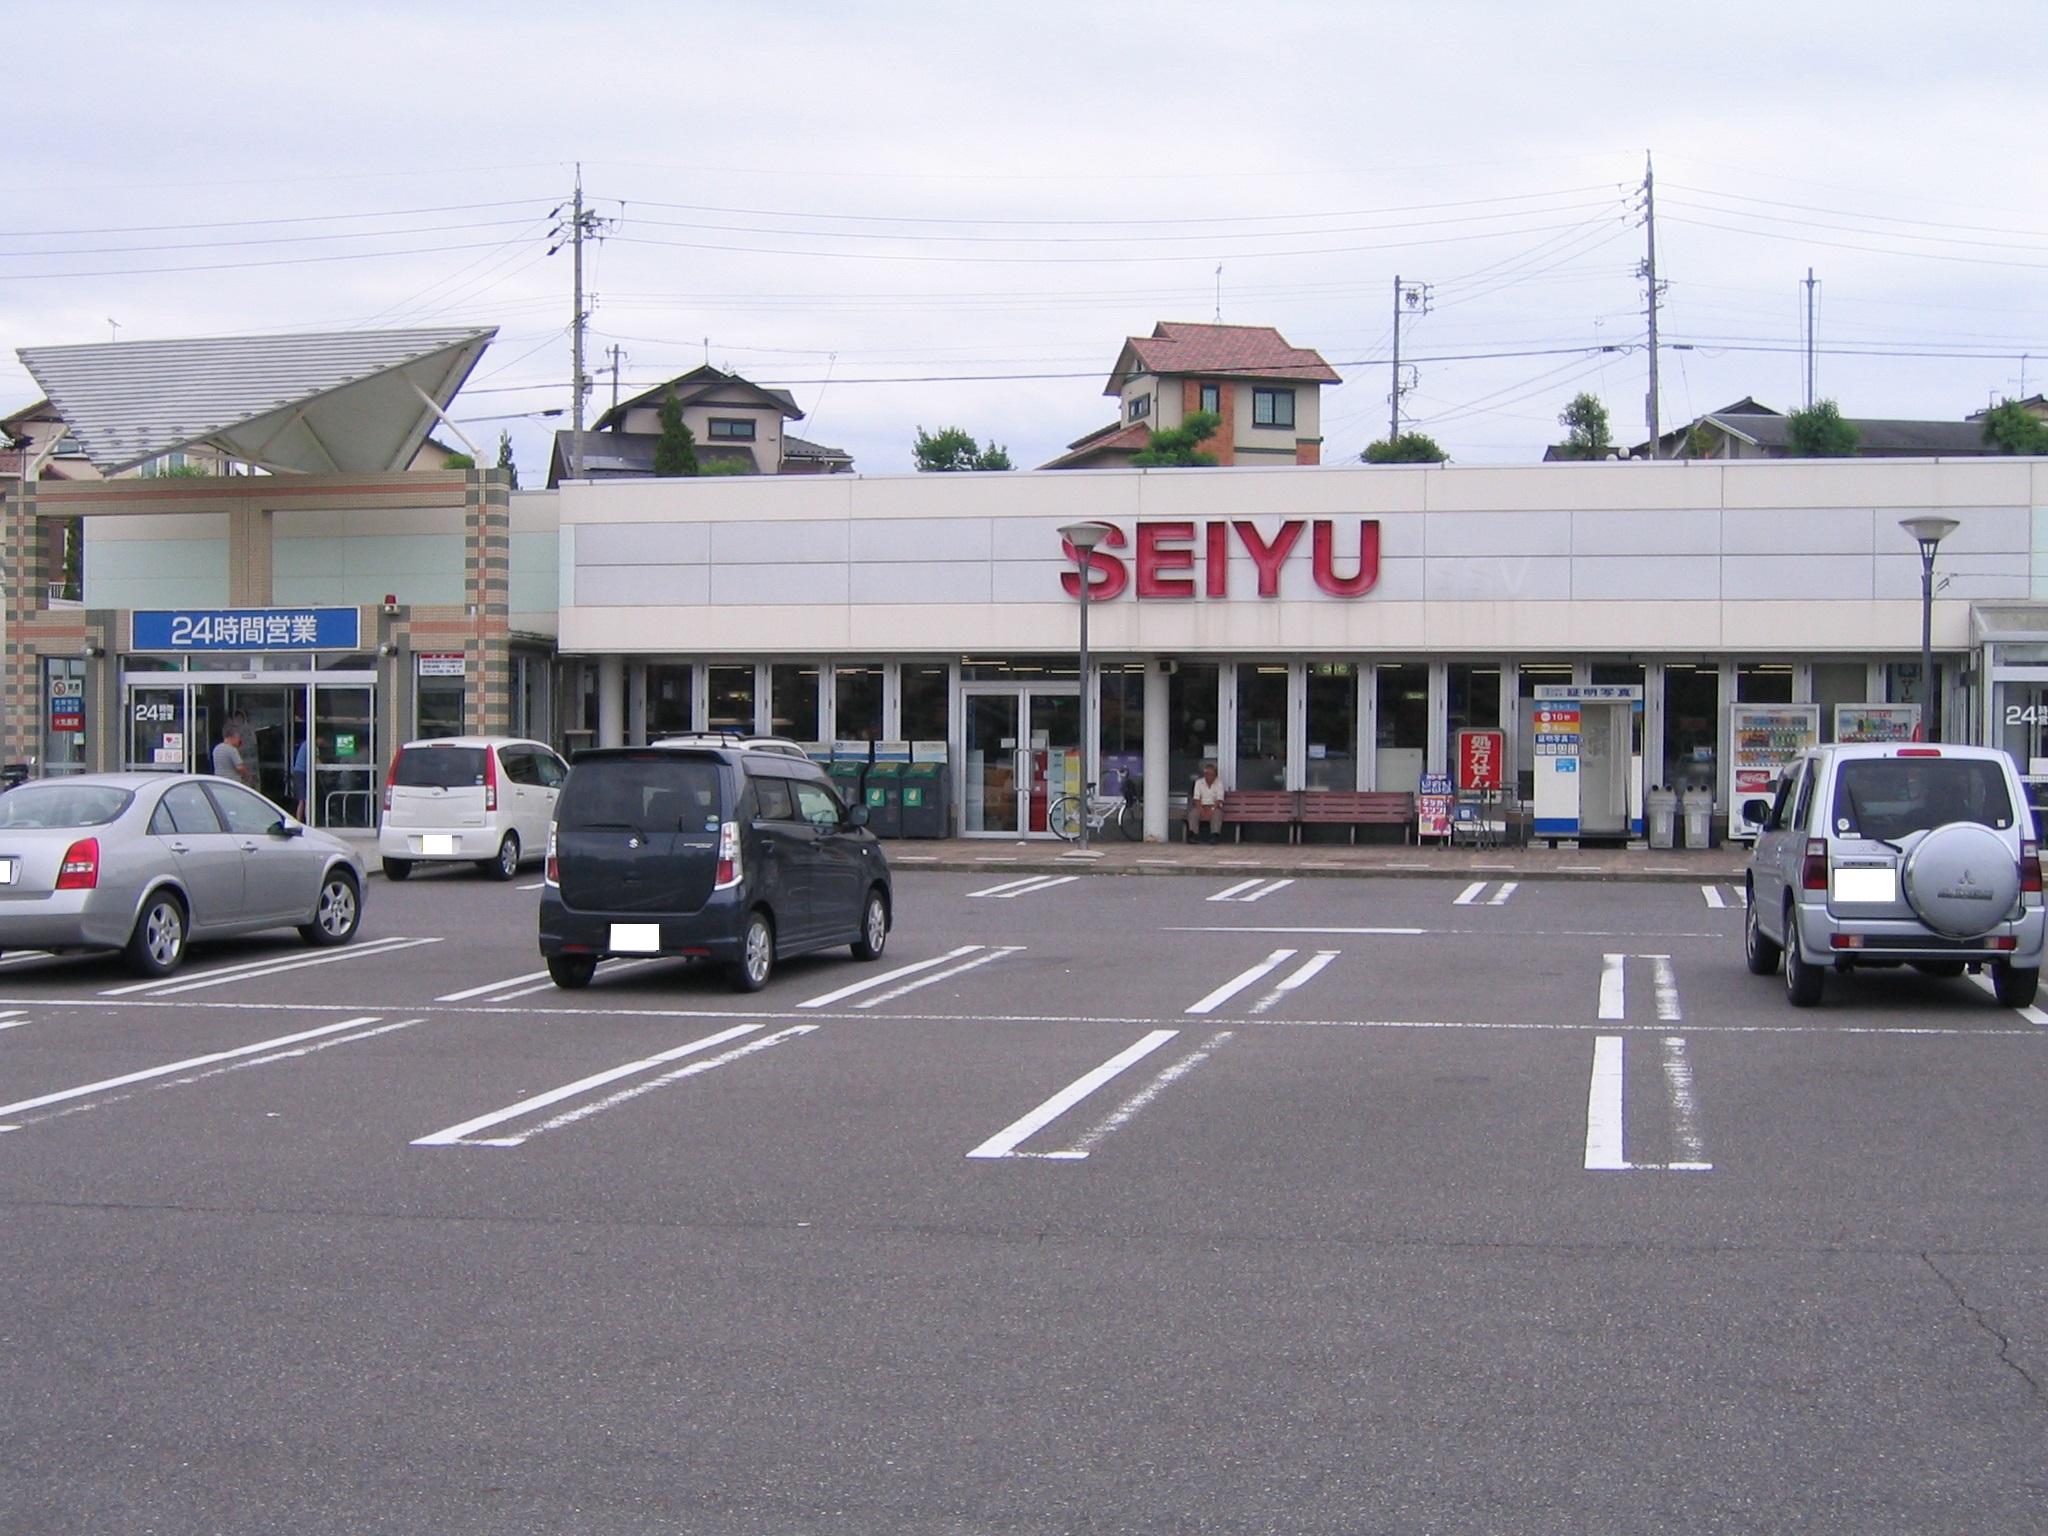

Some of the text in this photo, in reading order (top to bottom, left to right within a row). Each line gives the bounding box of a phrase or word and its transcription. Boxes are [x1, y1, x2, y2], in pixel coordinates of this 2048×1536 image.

[1060, 519, 1380, 600] SEIYU
[171, 614, 318, 645] 24時間営業
[1567, 687, 1631, 698] 証明写真
[136, 704, 158, 721] 24
[2006, 705, 2038, 725] 24
[1470, 735, 1491, 788] 処方せん
